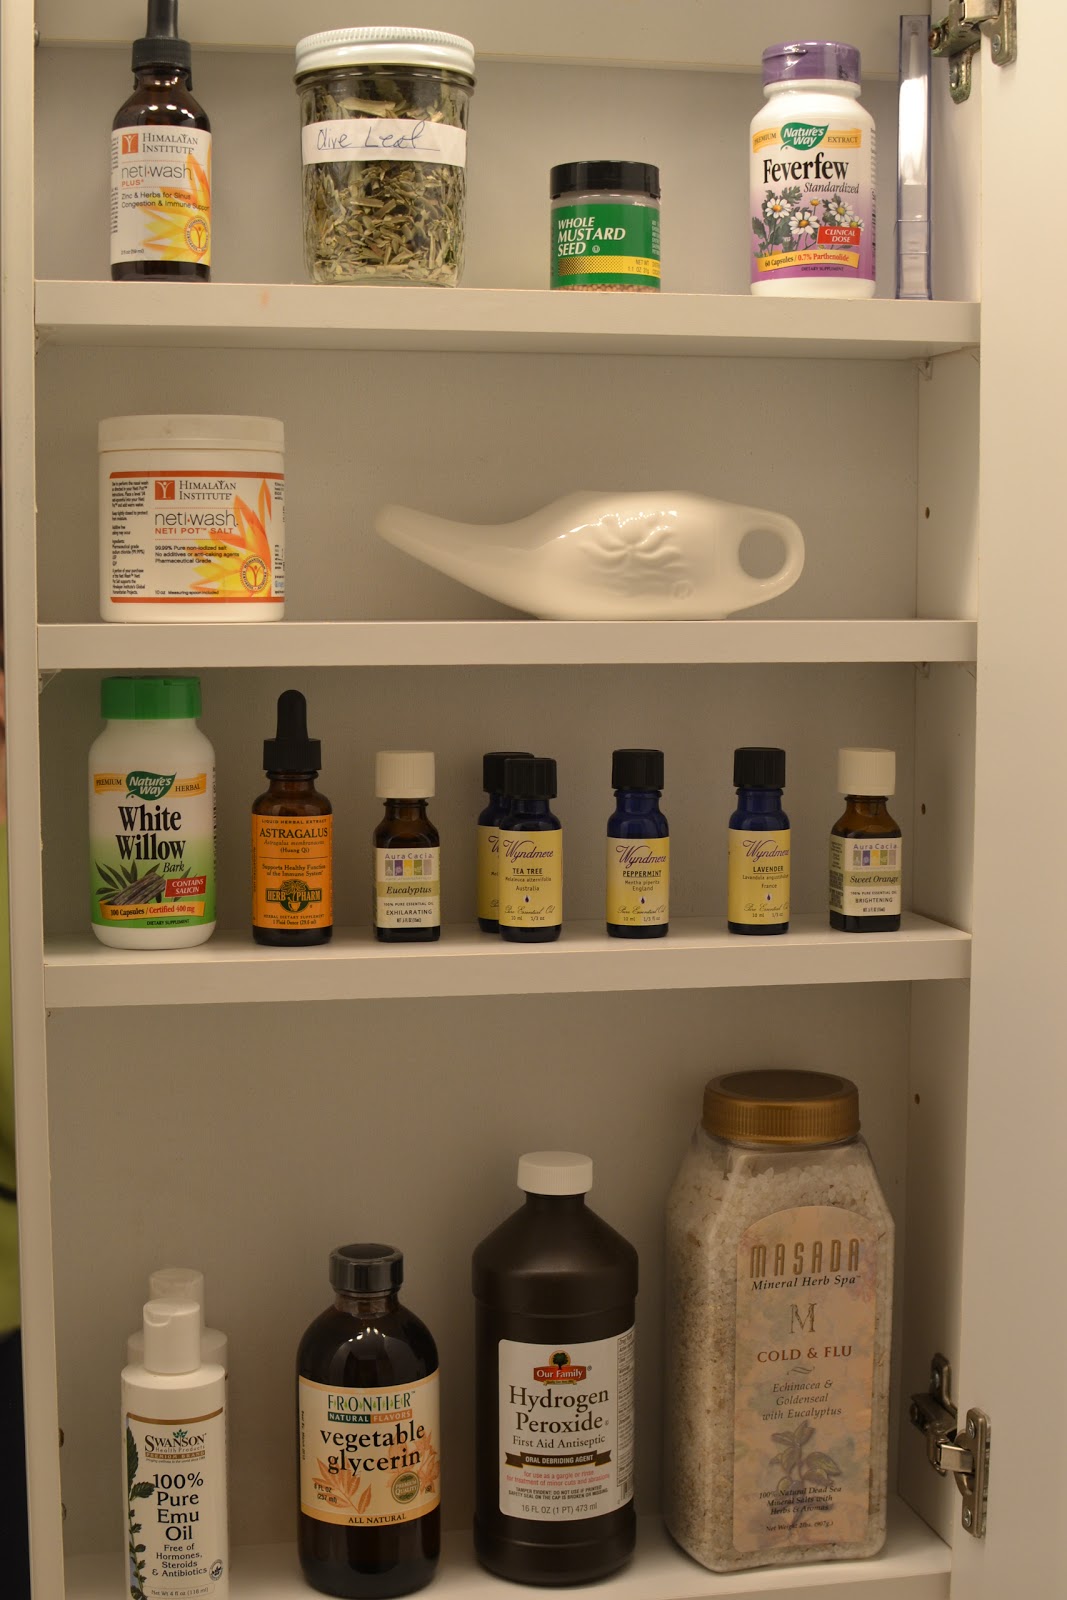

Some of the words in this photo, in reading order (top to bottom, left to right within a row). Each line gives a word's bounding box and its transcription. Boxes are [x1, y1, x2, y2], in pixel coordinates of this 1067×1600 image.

[142, 132, 198, 145] HIMALAYAN
[754, 132, 777, 144] PREMIUM
[784, 127, 824, 138] Nature's
[793, 136, 817, 147] Way
[142, 144, 193, 154] INSTITUTE
[763, 152, 849, 184] Feverfew
[804, 182, 860, 194] Standardized
[174, 192, 191, 200] Sinus
[122, 200, 156, 209] Congestion
[165, 200, 191, 208] Immune
[558, 216, 595, 230] WHOLE
[558, 227, 626, 243] MUSTARD
[824, 228, 856, 236] CLINICAL
[558, 242, 586, 256] SEED
[772, 256, 794, 267] Capsules
[814, 253, 849, 262] Parthenolide
[179, 480, 237, 490] HIMALAYAN
[179, 490, 231, 500] INSTITUTE
[129, 776, 172, 786] Nature's
[175, 783, 200, 792] HERBAL
[140, 785, 164, 797] Way
[118, 804, 182, 831] White
[260, 828, 328, 838] ASTRAGALUS
[116, 833, 186, 860] Willow
[163, 861, 184, 872] Bark
[172, 879, 204, 887] CONTAINS
[176, 886, 199, 894] SALICIN
[267, 890, 286, 900] HERB
[296, 890, 321, 900] PHARM
[386, 886, 432, 895] Eucalyptus
[120, 908, 144, 917] Capsules
[149, 905, 174, 914] Certified
[187, 906, 195, 914] mg
[750, 1238, 860, 1278] MASADA
[751, 1278, 798, 1291] Mineral
[802, 1276, 829, 1286] Herb
[789, 1302, 817, 1334] M
[757, 1349, 801, 1362] COLD
[807, 1348, 818, 1359] &
[824, 1345, 852, 1358] FLU
[537, 1369, 553, 1378] Our
[556, 1369, 583, 1378] Family
[773, 1381, 820, 1393] Echinacea
[824, 1380, 832, 1389] &
[328, 1392, 411, 1412] FRONTIER
[509, 1385, 609, 1413] Hydrogen
[776, 1393, 828, 1406] Goldenseal
[329, 1412, 369, 1422] NATURAL
[374, 1411, 411, 1421] FLAVORS
[763, 1410, 783, 1420] with
[788, 1407, 842, 1419] Eucalyptus
[516, 1411, 602, 1434] Peroxide
[320, 1420, 425, 1452] vegetable
[513, 1435, 533, 1448] First
[537, 1439, 554, 1448] Aid
[557, 1434, 605, 1448] Antiseptic
[145, 1434, 205, 1452] SWANSON
[328, 1447, 421, 1476] glycerin
[575, 1455, 593, 1463] AGENT
[153, 1472, 204, 1489] 100%
[556, 1472, 573, 1480] gargle
[157, 1491, 199, 1506] Pure
[553, 1506, 559, 1515] (1
[562, 1506, 573, 1514] PT)
[575, 1504, 588, 1512] 473
[157, 1509, 199, 1524] Emu
[366, 1513, 406, 1524] NATURAL
[166, 1525, 192, 1541] Oil
[162, 1568, 207, 1577] Antibiotics
